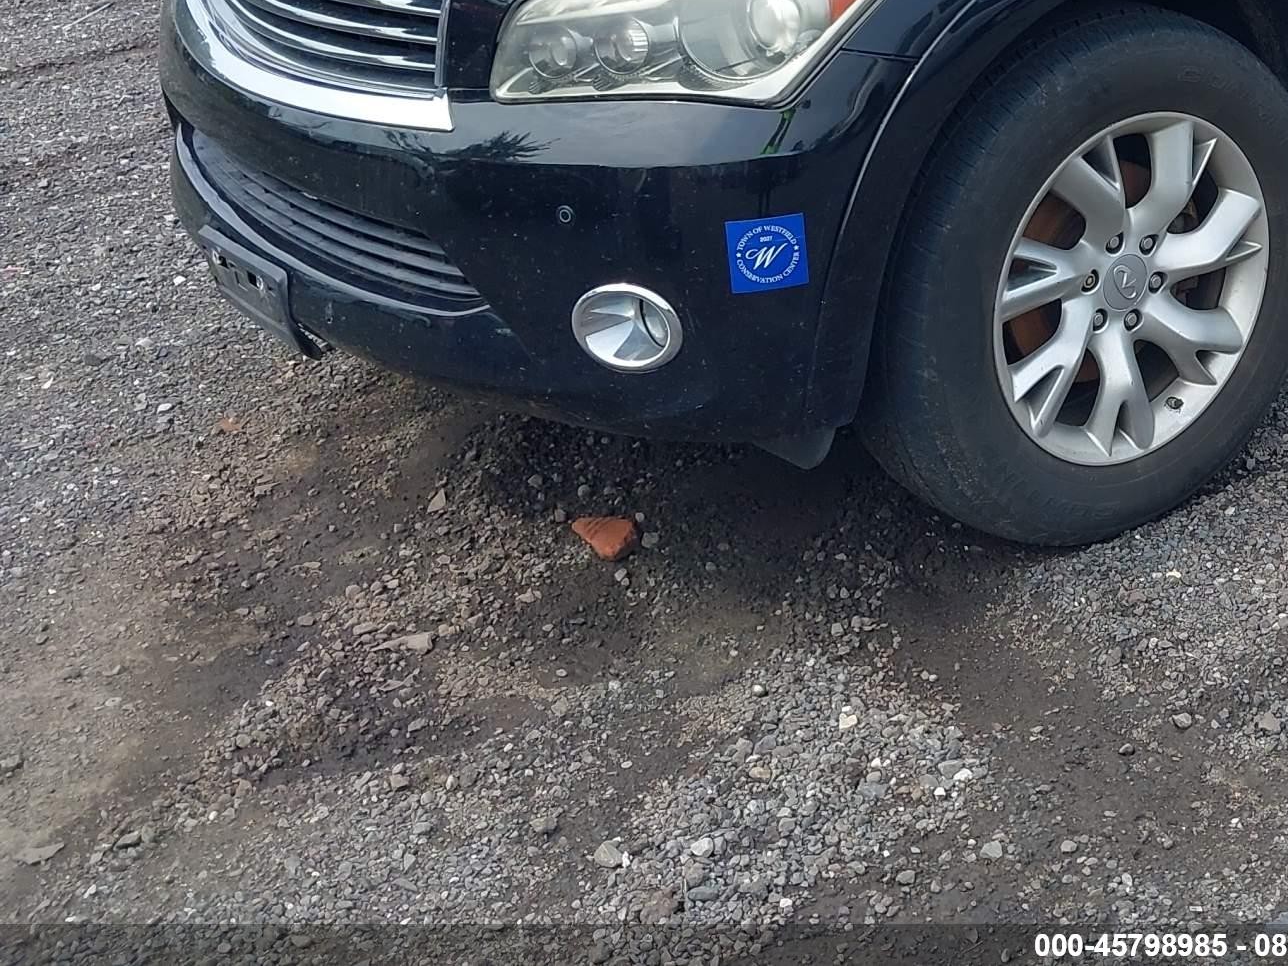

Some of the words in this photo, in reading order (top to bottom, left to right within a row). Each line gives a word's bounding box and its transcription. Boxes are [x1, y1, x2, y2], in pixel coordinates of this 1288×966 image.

[736, 231, 754, 251] TOWN
[753, 226, 763, 234] OF
[763, 225, 797, 245] WESTFIELD
[736, 259, 784, 284] CONSERVATION
[782, 251, 800, 277] CENTER
[745, 243, 788, 270] W
